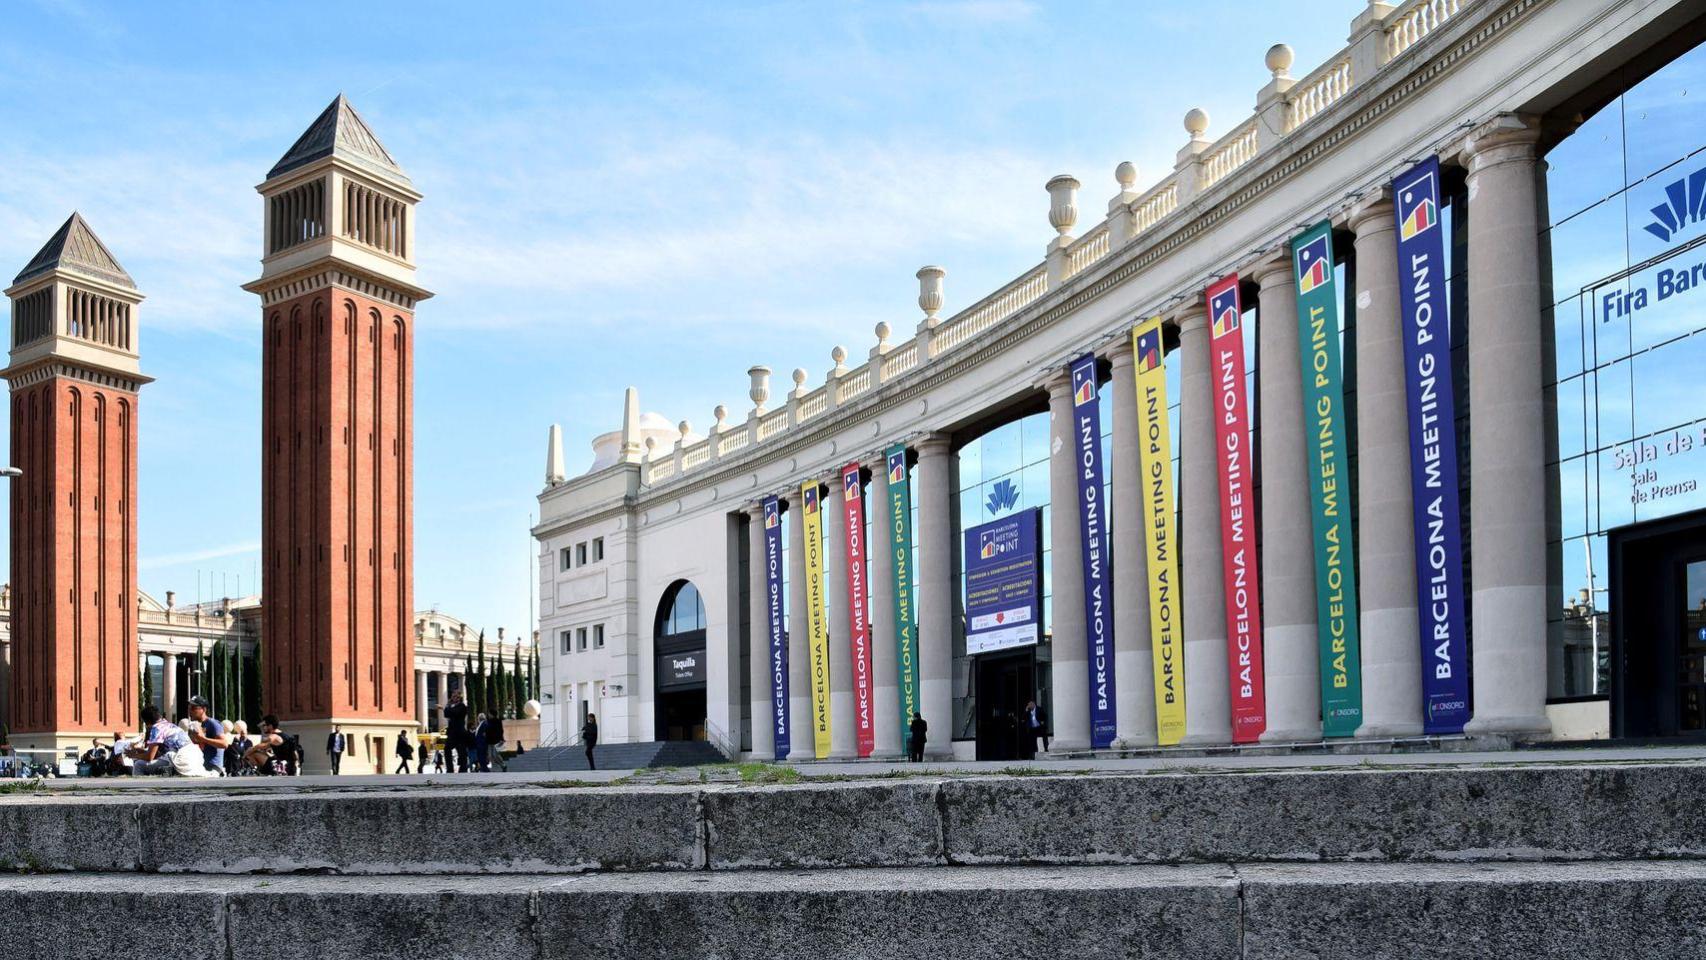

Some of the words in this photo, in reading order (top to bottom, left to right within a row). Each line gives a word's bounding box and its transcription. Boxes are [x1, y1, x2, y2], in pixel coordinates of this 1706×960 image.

[1411, 253, 1433, 346] POINT
[1603, 287, 1648, 324] Fira
[1310, 305, 1329, 388] POINT
[1146, 386, 1160, 454] POINT
[1221, 350, 1237, 425] POINT
[1418, 353, 1442, 488] MEETING
[1081, 416, 1094, 480] POINT
[1317, 395, 1338, 517] MEETING
[1613, 441, 1657, 470] Sala
[1664, 431, 1693, 456] de
[1630, 468, 1658, 487] Sala
[894, 493, 904, 543] POINT
[1152, 461, 1168, 561] MEETING
[1227, 431, 1244, 542] MEETING
[1631, 489, 1648, 504] de
[1651, 479, 1697, 500] Prensa
[769, 536, 777, 579] POINT
[808, 523, 817, 568] POINT
[849, 508, 859, 556] POINT
[995, 529, 1019, 543] MEETING
[995, 538, 1019, 555] POINT
[1086, 485, 1100, 579] MEETING
[771, 583, 781, 646] MEETING
[811, 572, 821, 639] MEETING
[852, 560, 863, 631] MEETING
[896, 549, 909, 622] MEETING
[1325, 524, 1347, 688] BARCELONA
[1427, 495, 1451, 680] BARCELONA
[1093, 584, 1108, 711] BARCELONA
[1158, 568, 1175, 704] BARCELONA
[1234, 548, 1252, 699] BARCELONA
[672, 657, 696, 670] Taquilla
[774, 650, 785, 735] BARCELONA
[815, 644, 826, 732] BARCELONA
[856, 634, 869, 729] BARCELONA
[902, 626, 914, 726] BARCELONA
